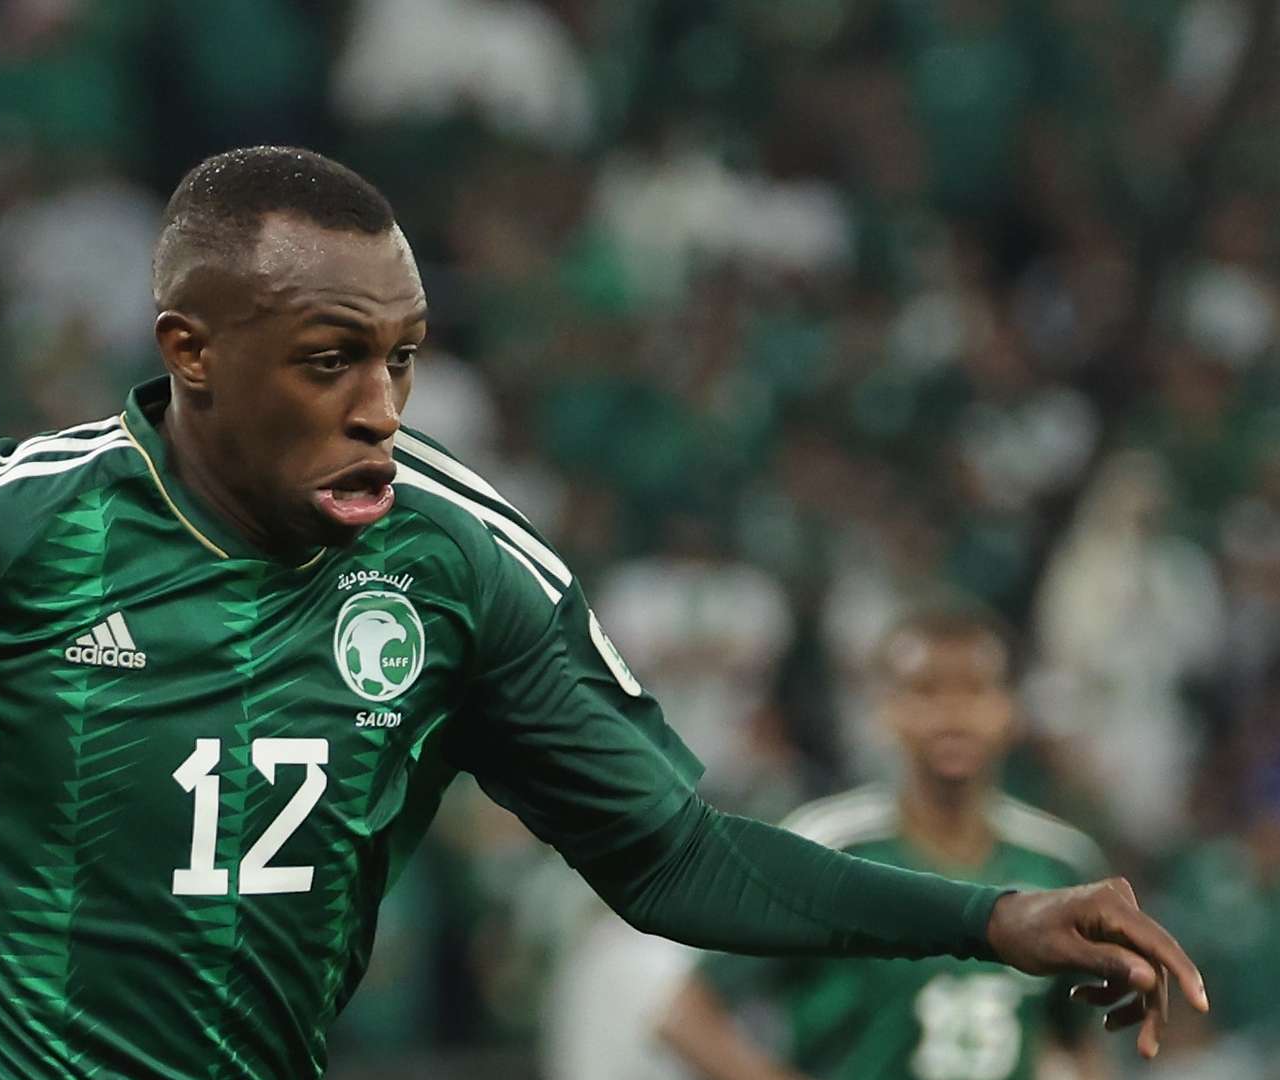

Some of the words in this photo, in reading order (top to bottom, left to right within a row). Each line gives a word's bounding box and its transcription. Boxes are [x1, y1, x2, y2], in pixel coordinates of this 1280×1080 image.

[337, 569, 414, 592] السعودية
[65, 644, 147, 668] adidas
[381, 656, 409, 668] SAFF
[354, 710, 402, 728] SAUDI
[172, 738, 329, 896] 12
